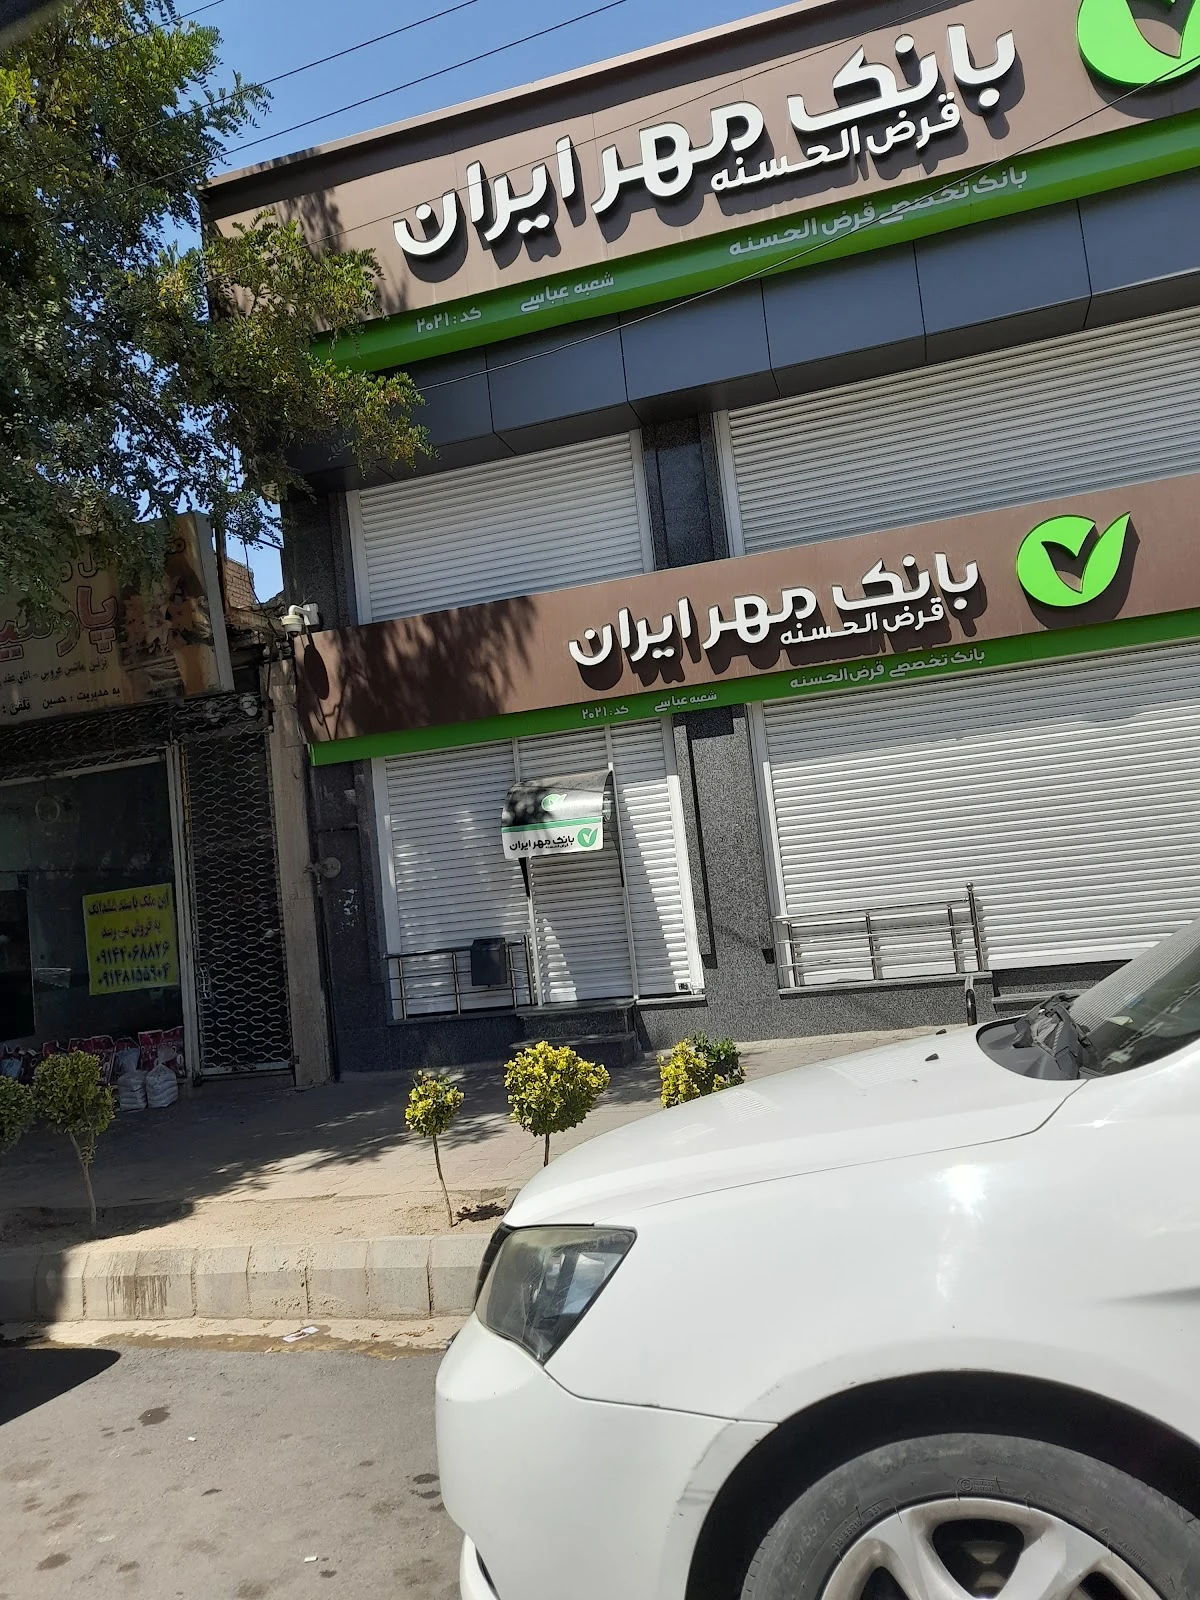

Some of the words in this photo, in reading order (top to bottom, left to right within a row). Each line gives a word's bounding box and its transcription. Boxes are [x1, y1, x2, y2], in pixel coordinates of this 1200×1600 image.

[788, 25, 1014, 131] بانک
[866, 92, 960, 156] قرض
[592, 102, 763, 213] مهر
[711, 125, 861, 192] الحسنه
[973, 166, 1028, 195] بانک
[393, 137, 576, 254] ایران
[879, 180, 970, 225] تخصصی
[821, 201, 876, 236] قرض
[729, 217, 818, 256] الحسنه
[573, 271, 615, 297] شعبه
[520, 286, 569, 313] عباسی
[416, 311, 449, 333] ۲۰۲۱
[832, 554, 978, 611] بانک
[702, 588, 817, 650] مهر
[780, 611, 879, 645] الحسنه
[883, 597, 944, 633] قرض
[568, 598, 692, 666] ایران
[888, 655, 949, 678] تخصصی
[951, 649, 986, 665] بانک
[789, 666, 849, 689] الحسنه
[849, 662, 884, 684] قرض
[112, 687, 121, 697] به
[653, 695, 688, 713] عباسی
[689, 690, 718, 707] شعبه
[582, 707, 608, 720] ۲۰۲۱
[509, 840, 531, 851] ایران
[532, 839, 551, 849] مهر
[552, 835, 575, 845] بانک
